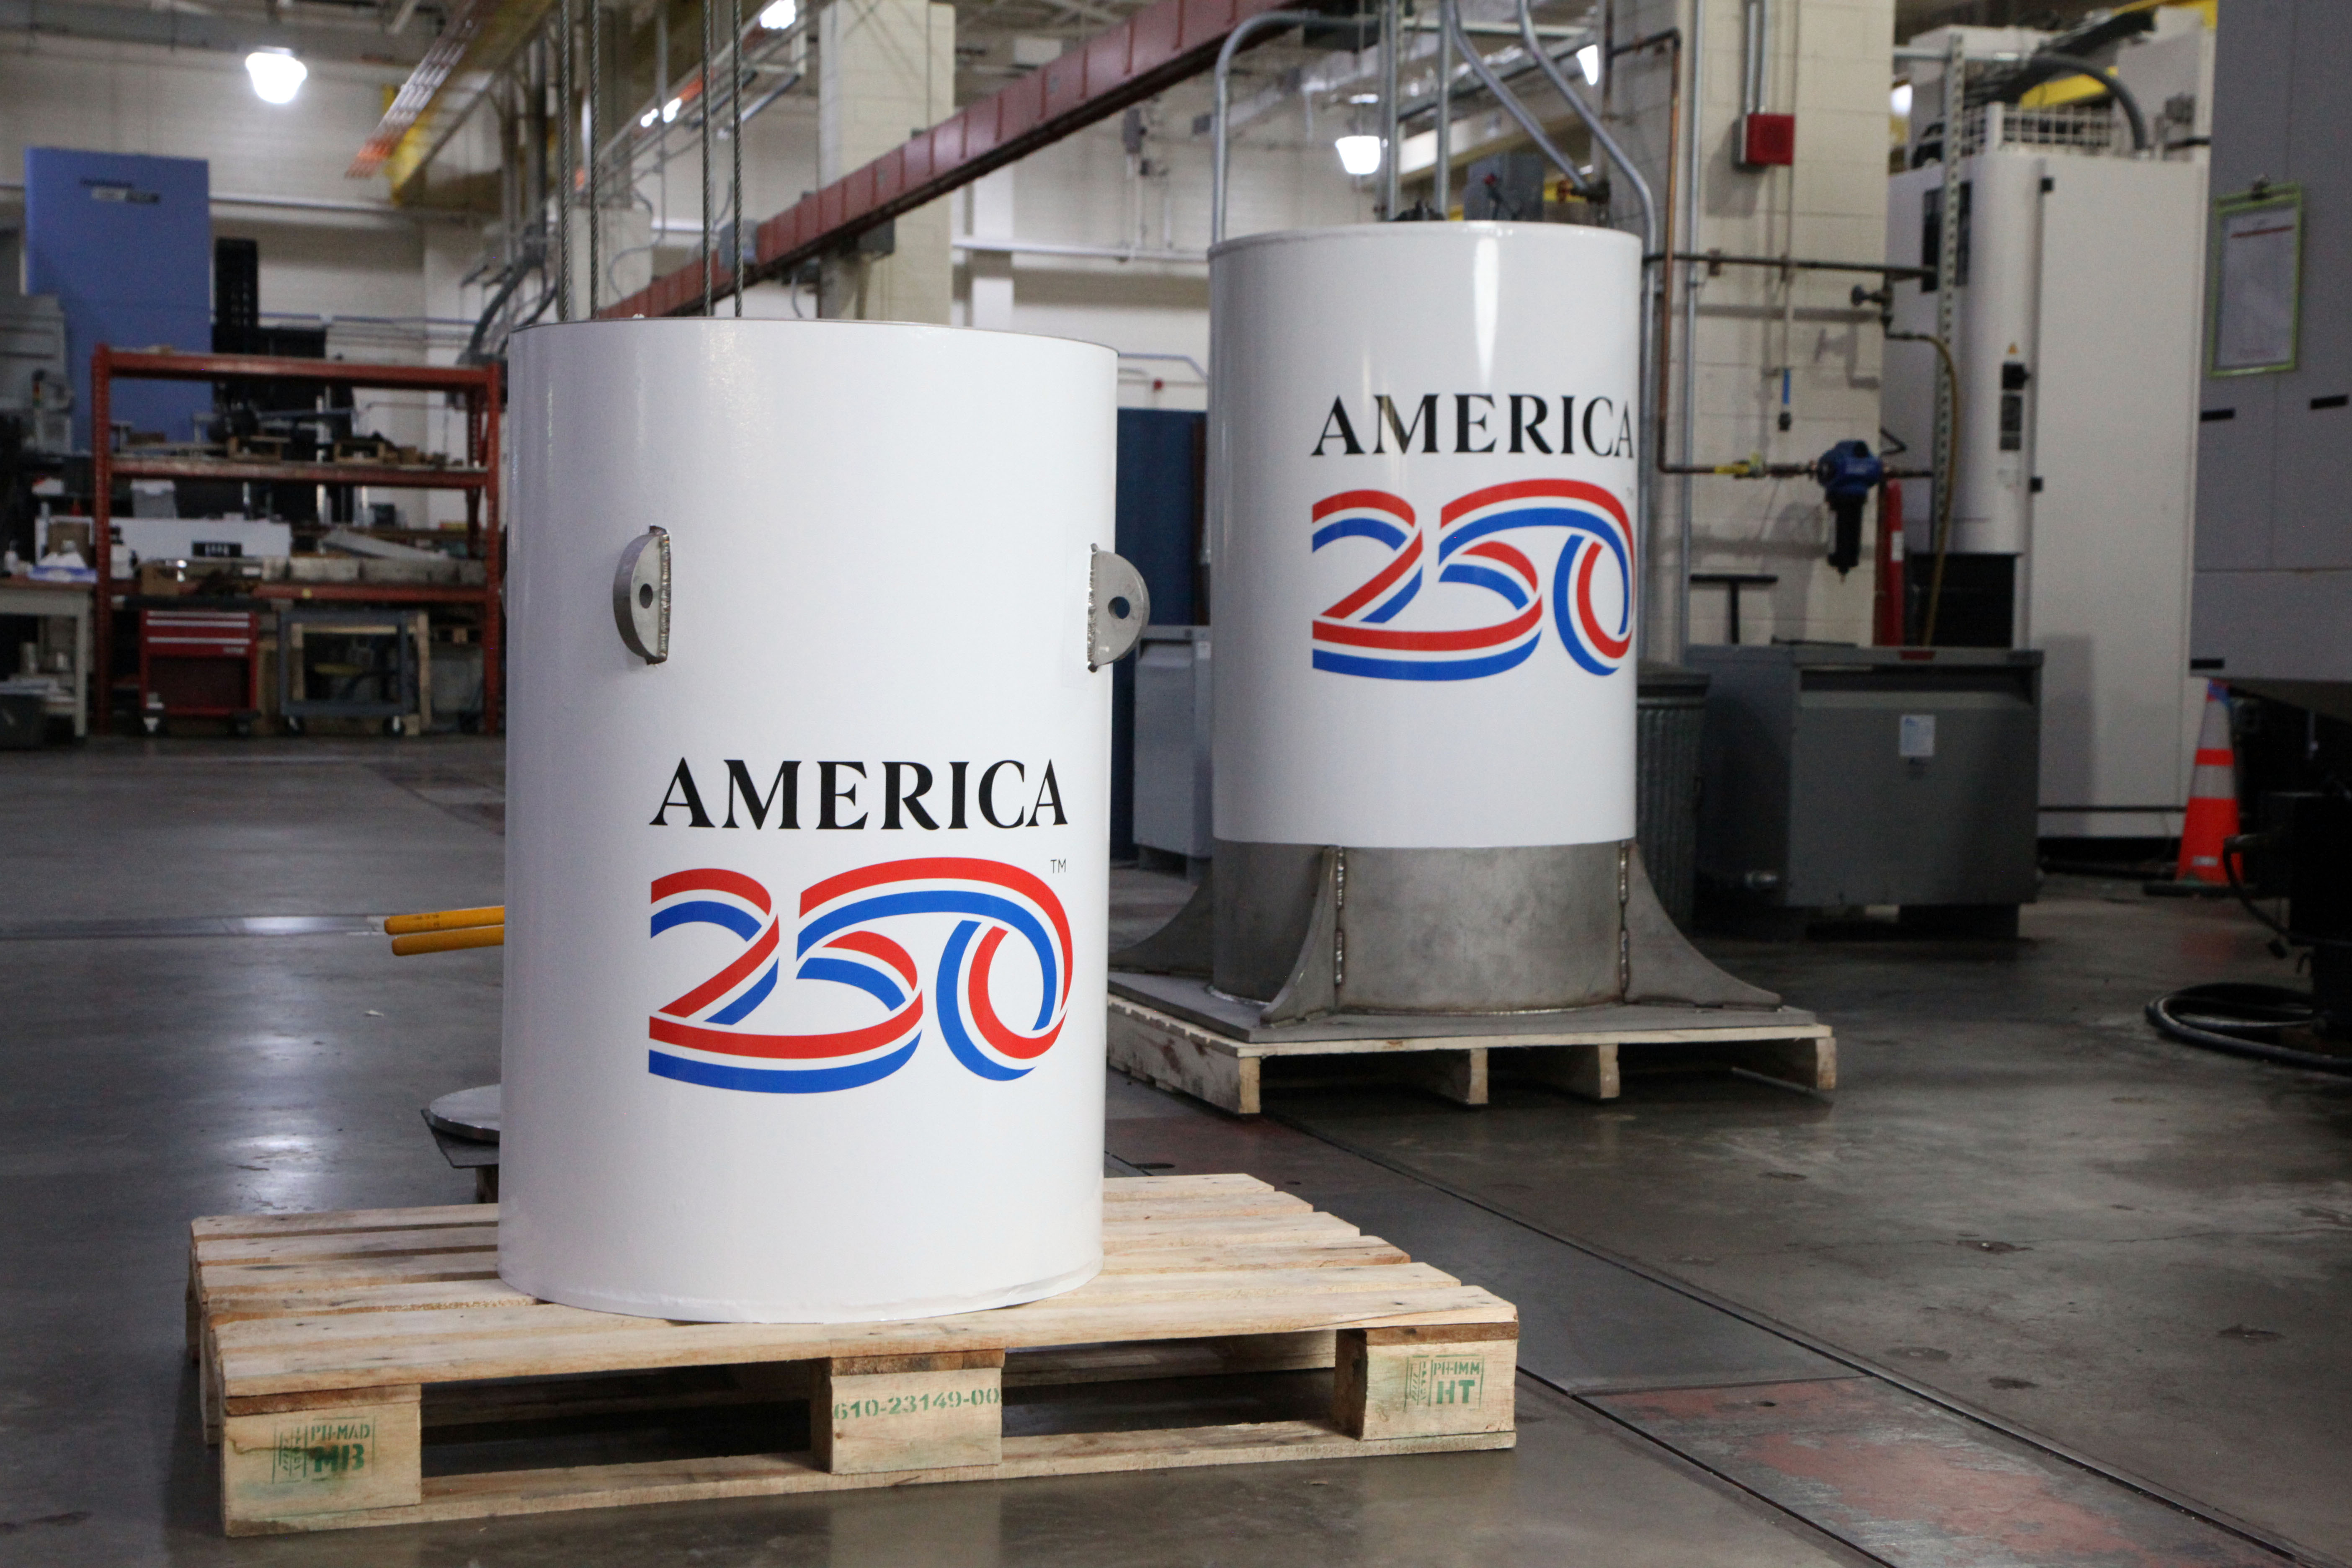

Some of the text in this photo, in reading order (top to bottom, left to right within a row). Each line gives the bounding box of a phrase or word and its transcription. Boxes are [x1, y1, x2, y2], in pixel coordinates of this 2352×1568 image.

[1310, 394, 1634, 459] AMERICA
[1312, 479, 1636, 681] 250
[649, 757, 1068, 830] AMERICA
[1050, 859, 1066, 873] TM
[649, 857, 1073, 1093] 250
[834, 1387, 999, 1420] 610-23149-00
[1436, 1380, 1475, 1404] HT
